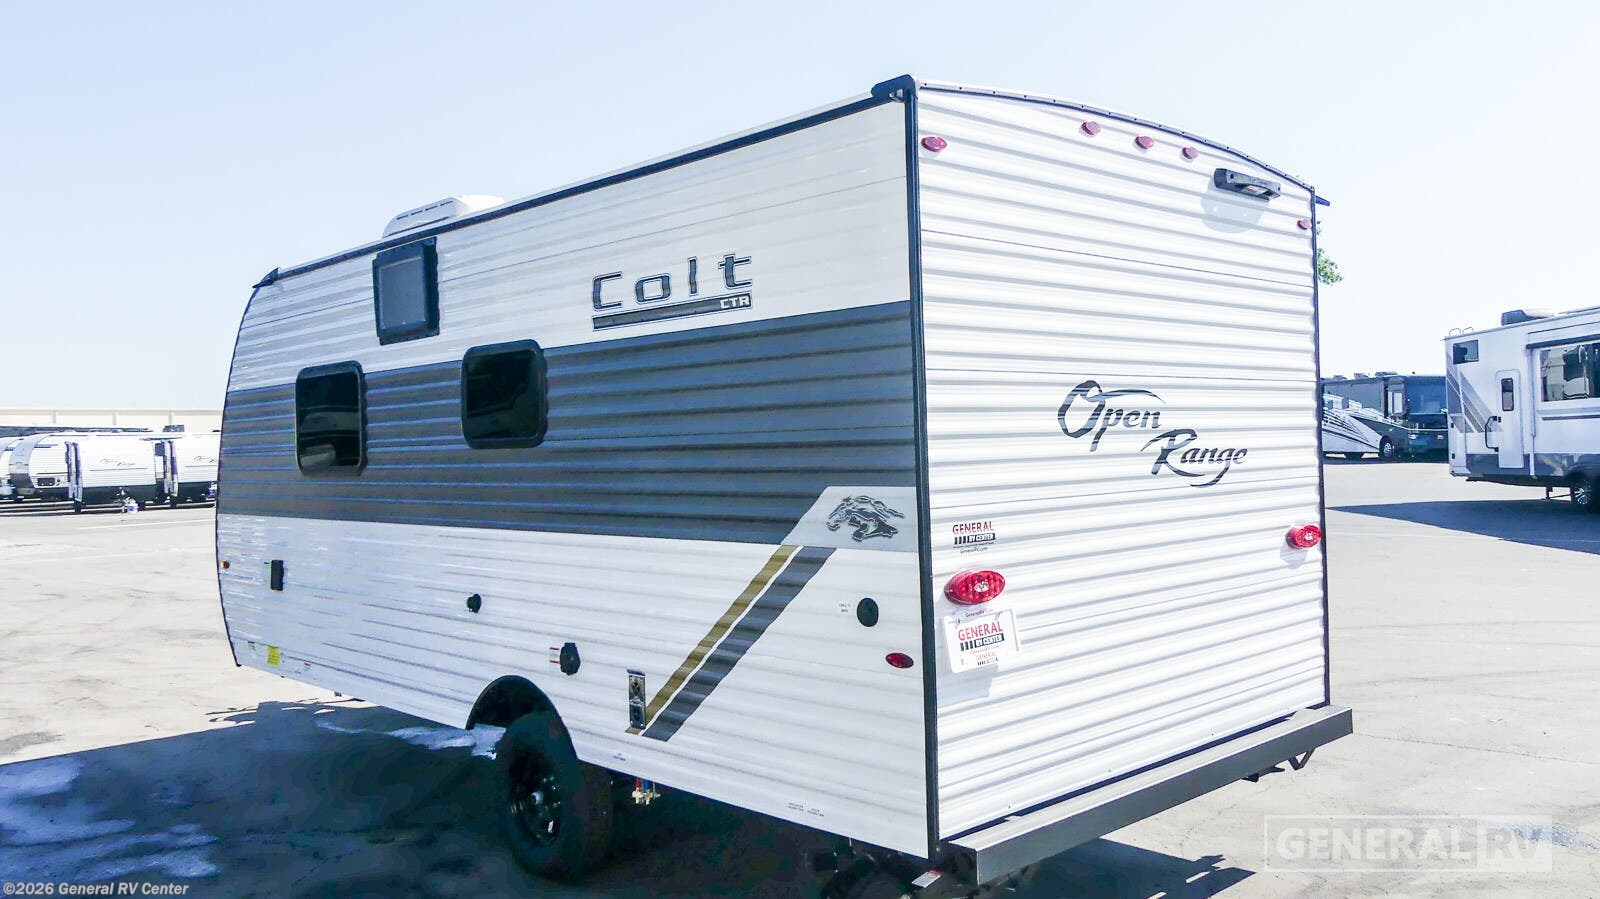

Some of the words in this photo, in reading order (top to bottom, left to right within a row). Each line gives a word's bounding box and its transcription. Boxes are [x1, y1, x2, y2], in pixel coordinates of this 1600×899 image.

[592, 253, 752, 312] Colt
[720, 296, 750, 309] CTR
[1057, 380, 1166, 453] Open
[1140, 428, 1248, 488] Range
[952, 521, 995, 536] GENERAL
[958, 621, 1003, 641] GENERAL
